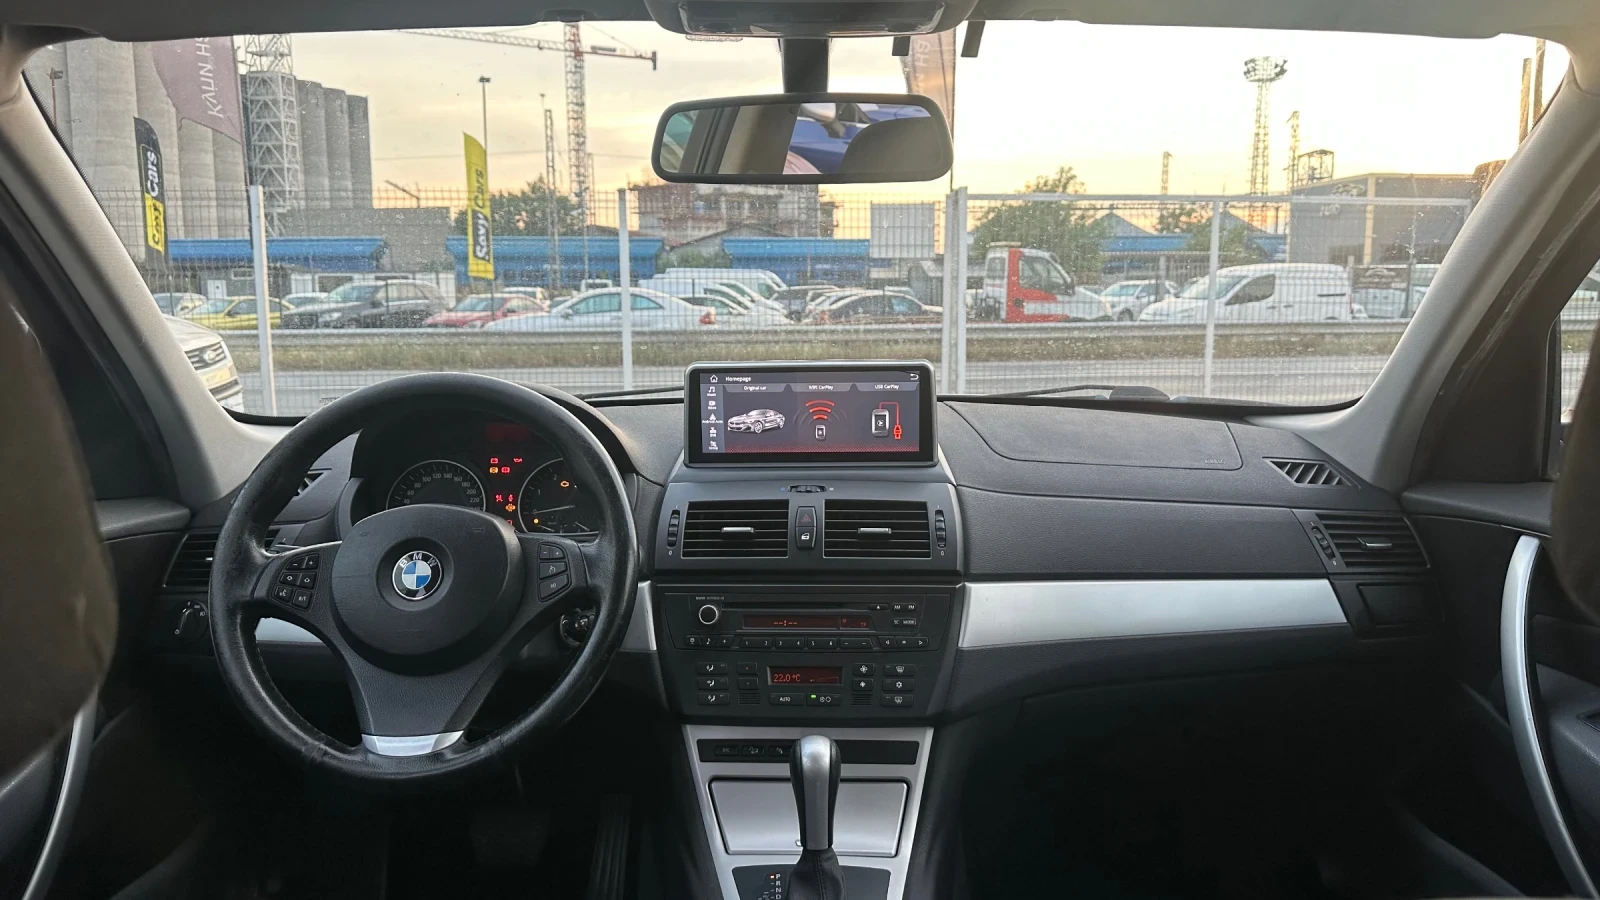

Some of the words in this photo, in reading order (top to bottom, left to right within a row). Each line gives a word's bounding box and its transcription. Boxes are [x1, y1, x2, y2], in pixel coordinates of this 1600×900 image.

[146, 151, 159, 197] Cars
[399, 552, 438, 568] BMW
[774, 674, 790, 682] 22.0
